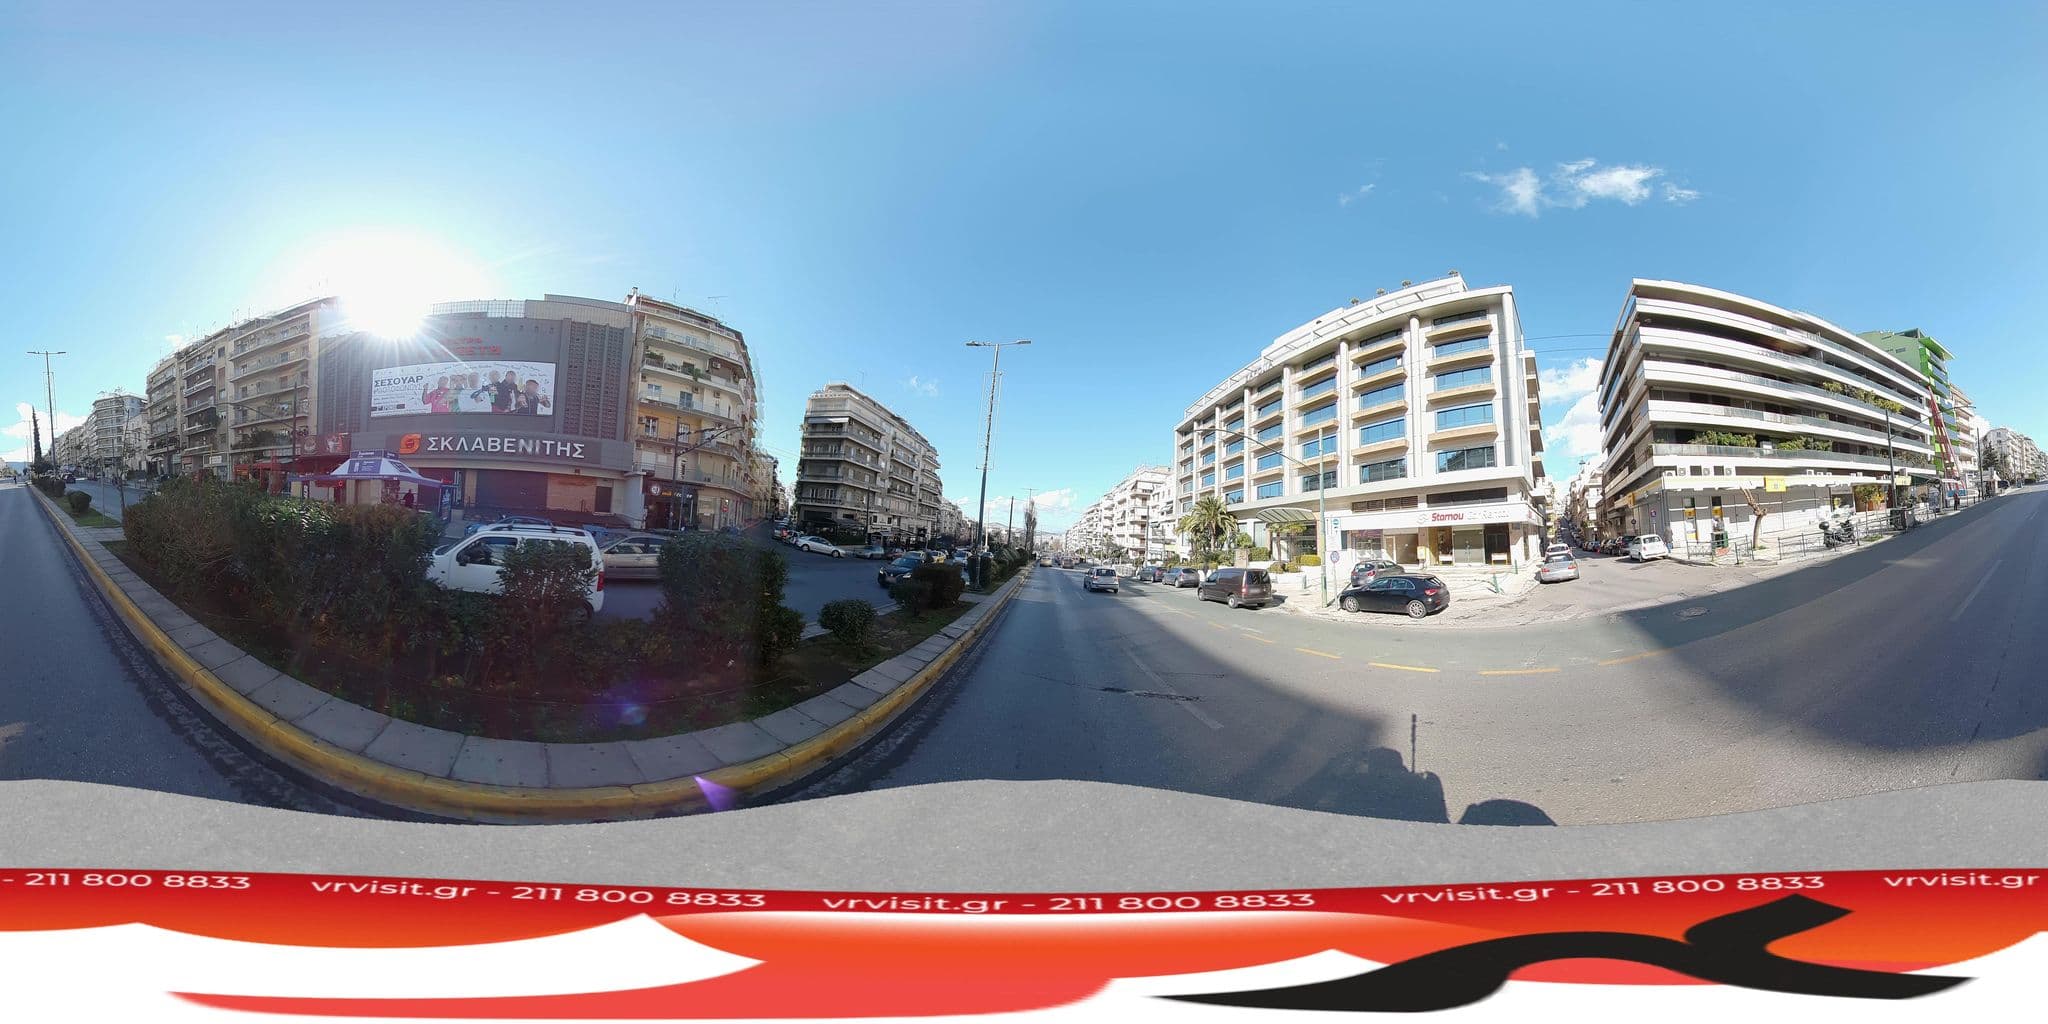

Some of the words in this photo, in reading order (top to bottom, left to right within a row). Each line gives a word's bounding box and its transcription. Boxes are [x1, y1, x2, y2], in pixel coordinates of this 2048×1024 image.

[374, 375, 424, 387] ΣΕΣΟΥΑΡ
[427, 436, 585, 459] ΣΚΛΑΒΕΝΙΤΗΣ
[1431, 512, 1464, 522] Stamou
